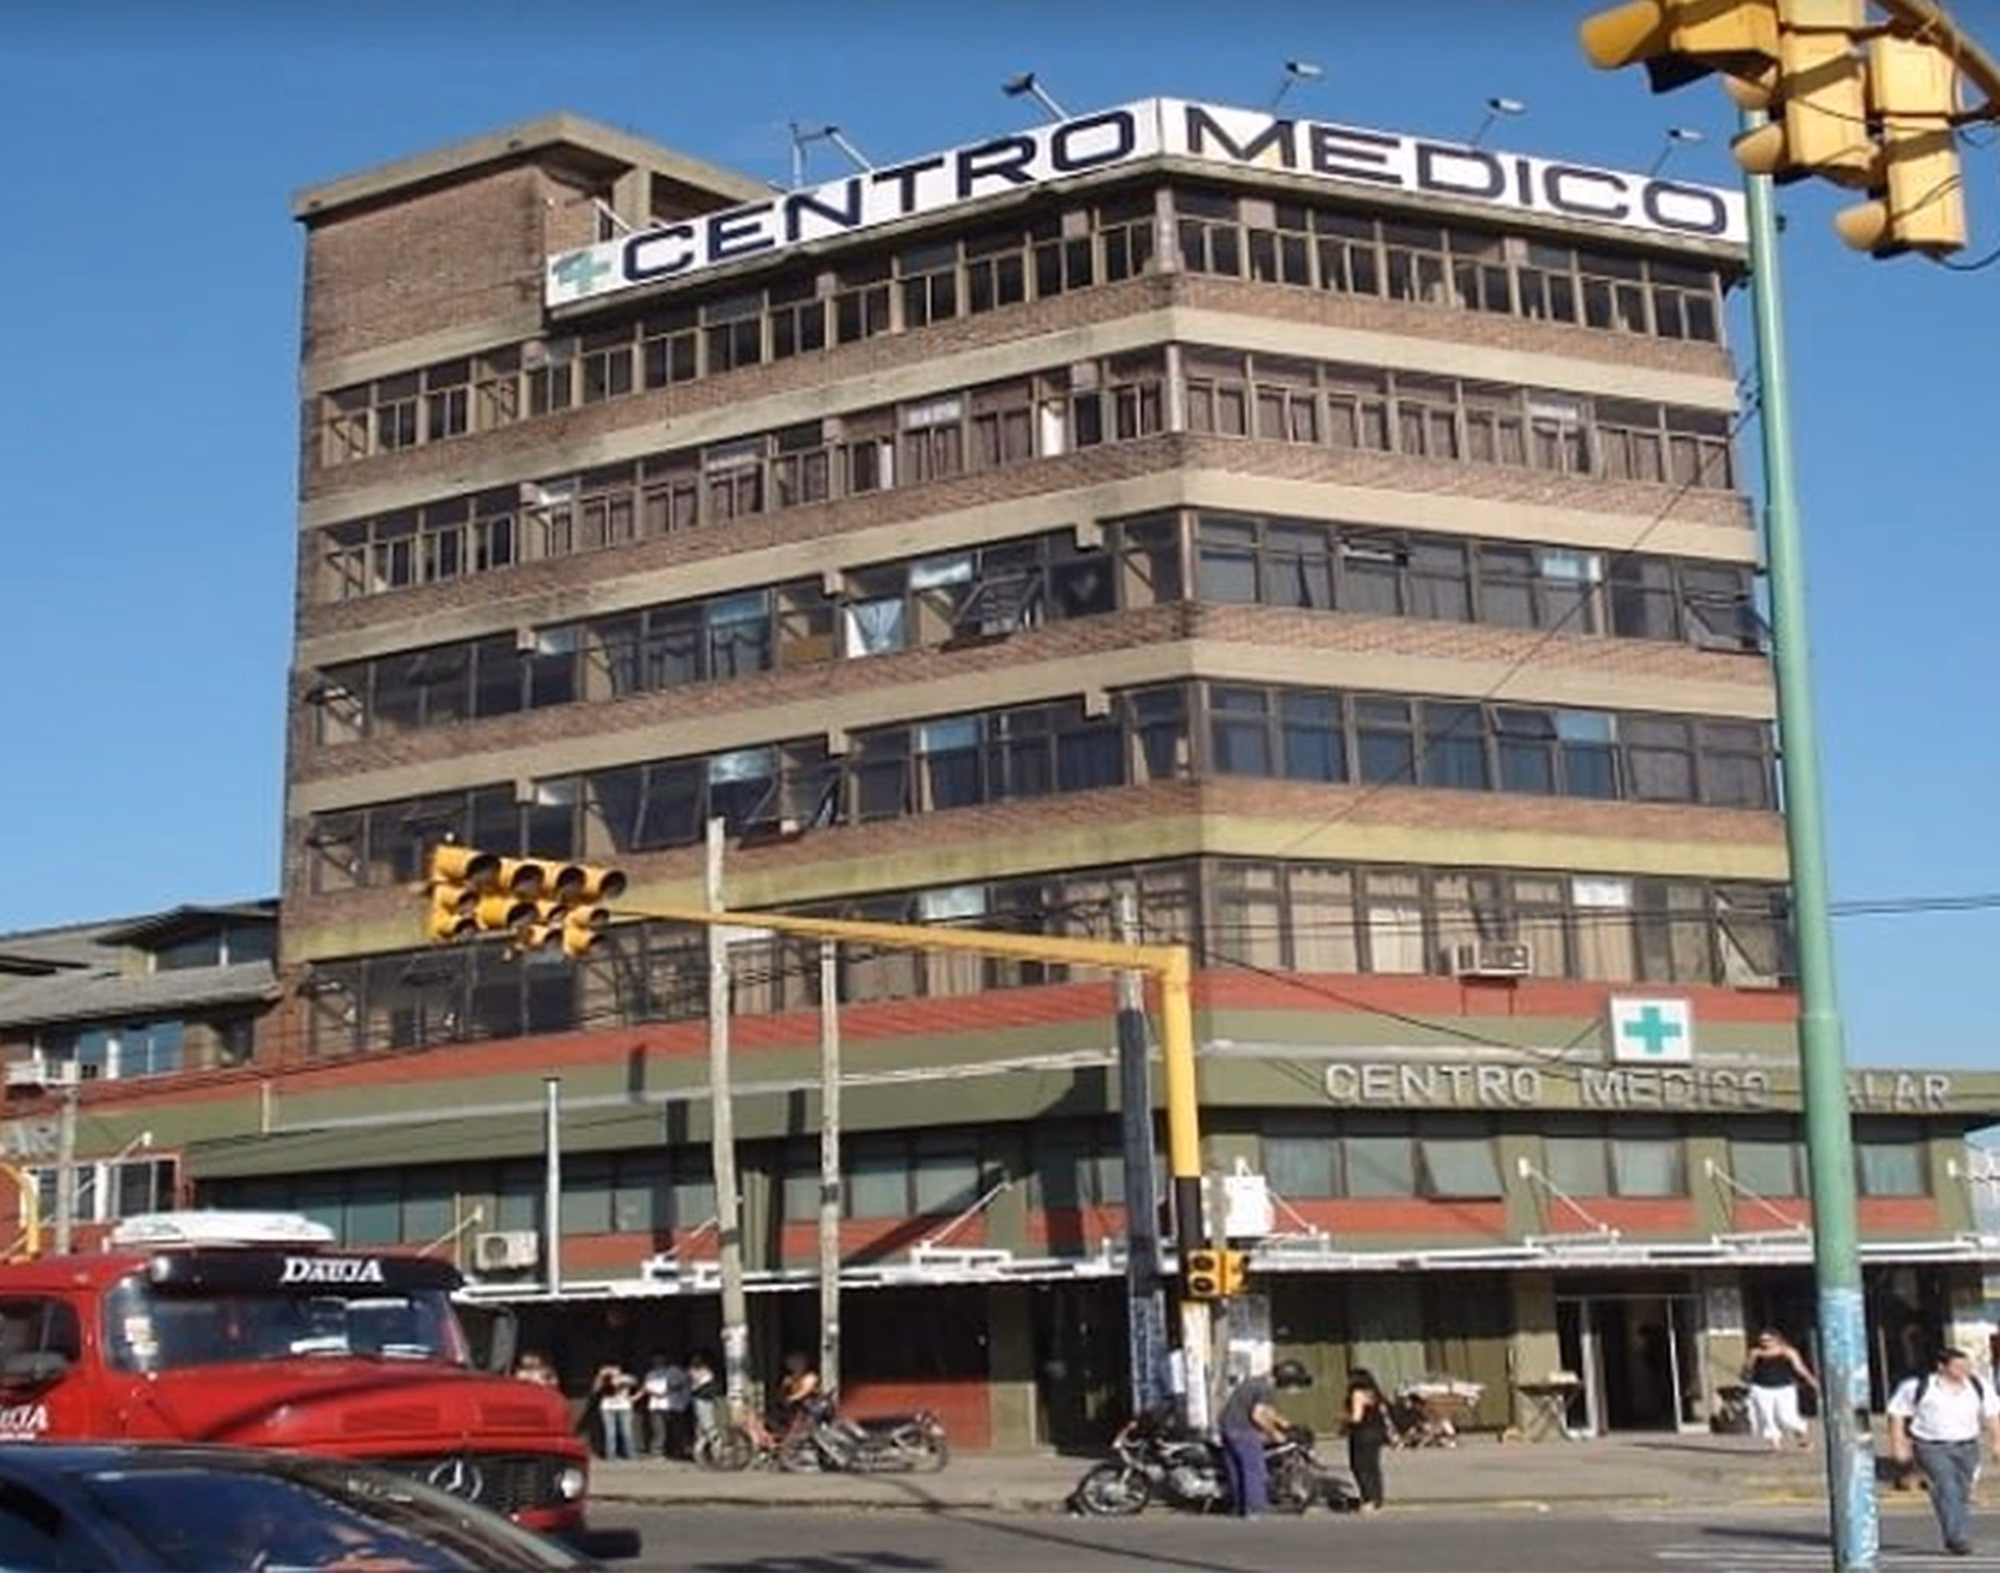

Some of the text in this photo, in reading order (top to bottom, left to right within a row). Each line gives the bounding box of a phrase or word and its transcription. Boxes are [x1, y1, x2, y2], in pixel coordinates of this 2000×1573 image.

[622, 106, 1728, 283] CENTRO MEDICO
[1326, 1064, 1952, 1112] CENTRO MEDICO LAR
